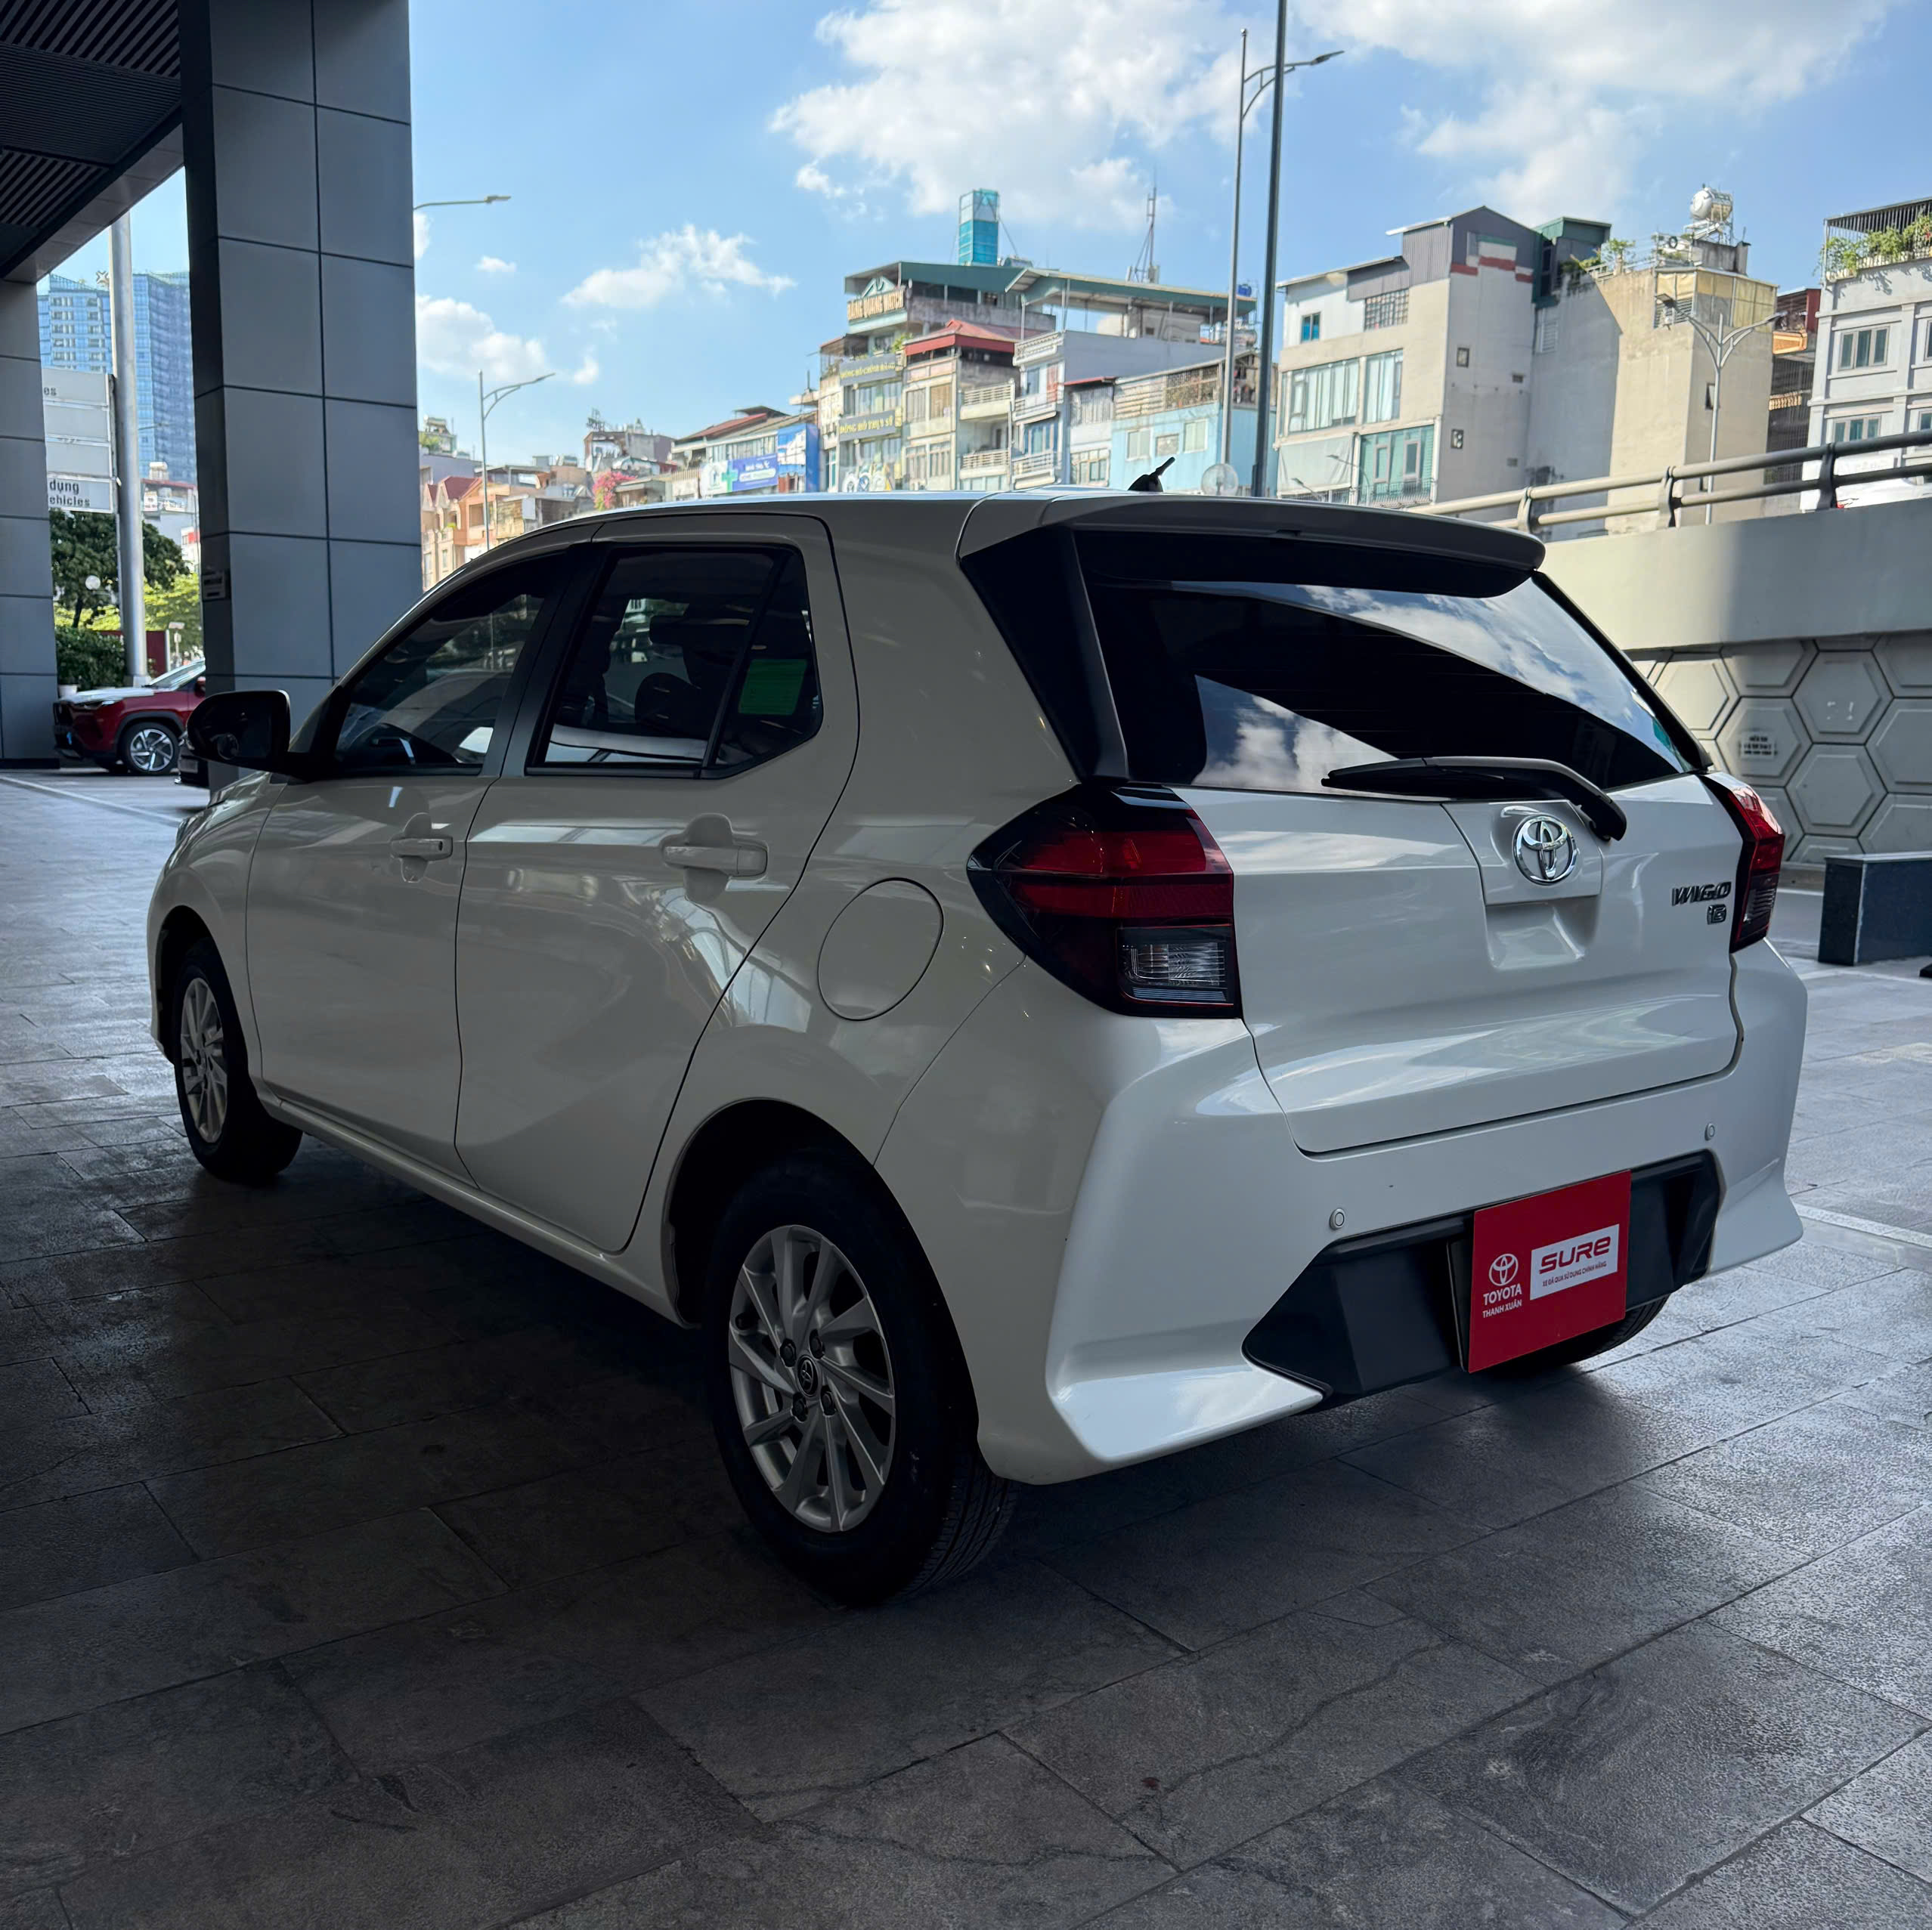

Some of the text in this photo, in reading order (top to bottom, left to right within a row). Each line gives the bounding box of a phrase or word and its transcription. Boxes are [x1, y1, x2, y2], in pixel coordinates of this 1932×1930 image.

[49, 478, 79, 495] dụng
[49, 495, 91, 507] ehicles
[1671, 881, 1732, 907] WIGO
[1539, 1236, 1611, 1275] SURE
[1554, 1275, 1564, 1283] QUA
[1483, 1283, 1522, 1306] TOYOTA
[1482, 1298, 1522, 1319] THANH XUÂN
